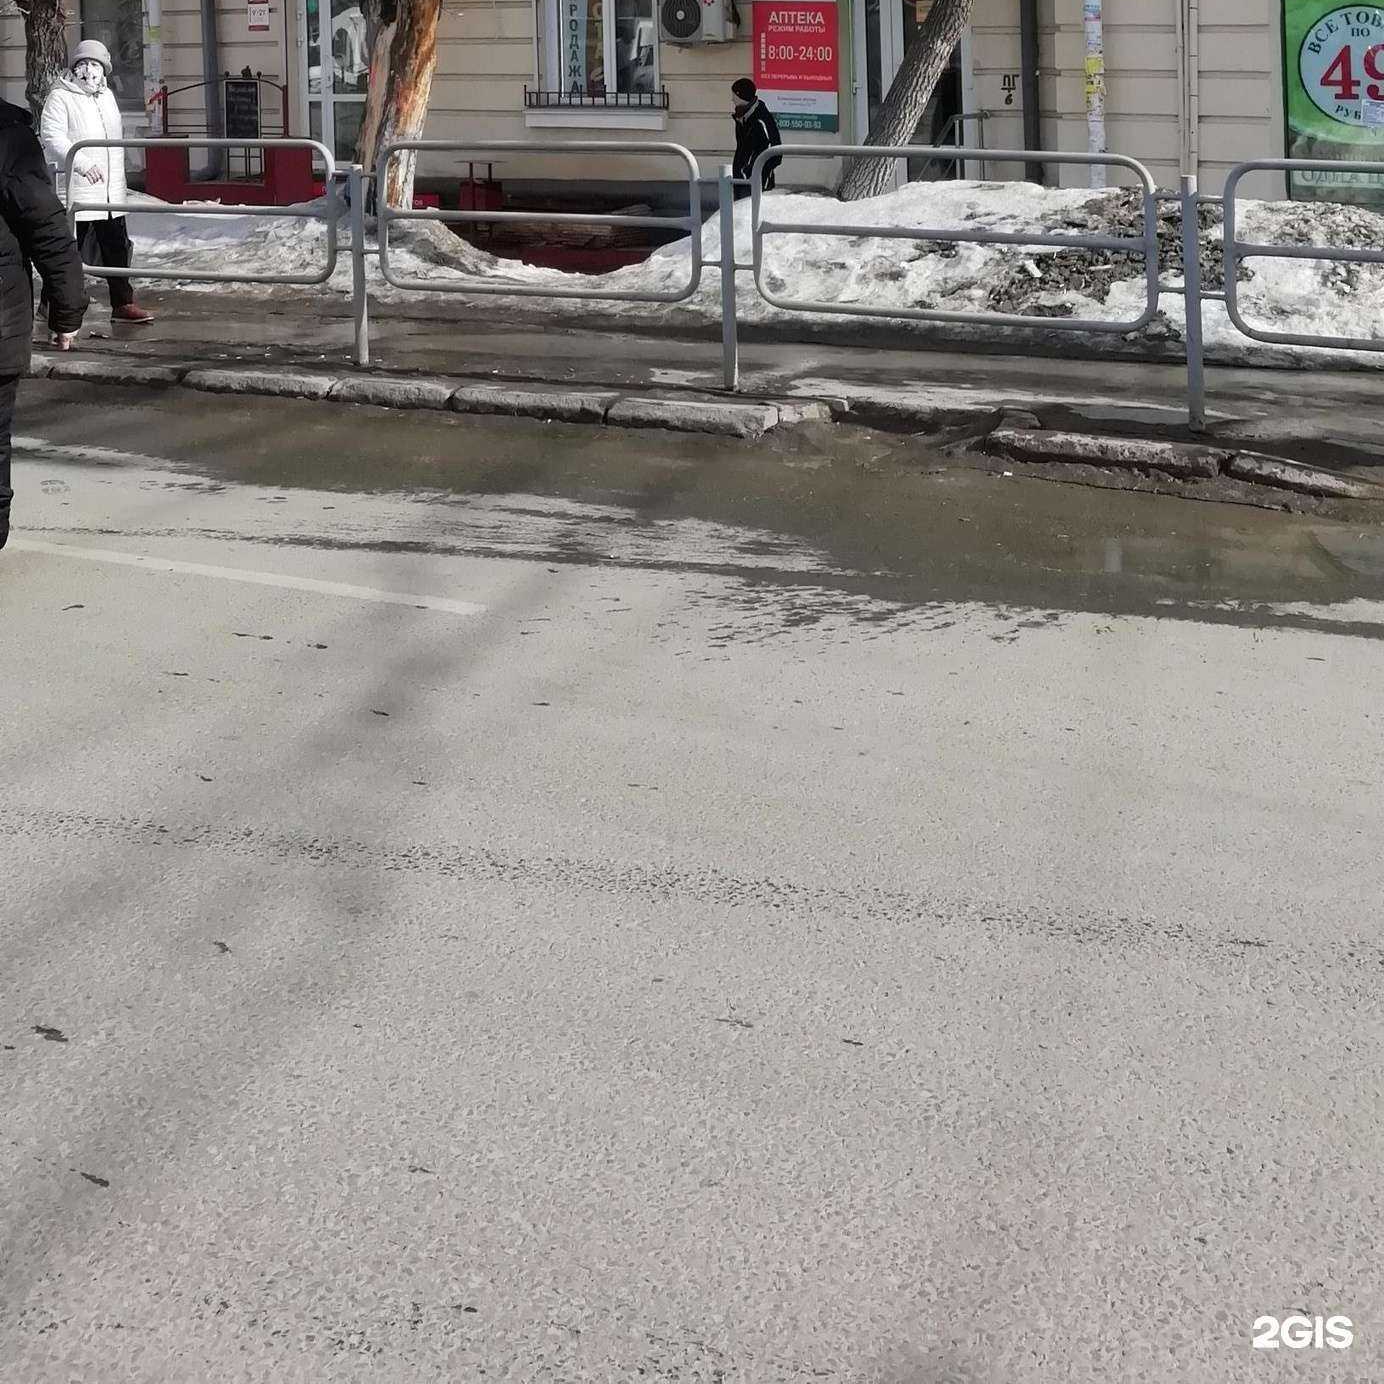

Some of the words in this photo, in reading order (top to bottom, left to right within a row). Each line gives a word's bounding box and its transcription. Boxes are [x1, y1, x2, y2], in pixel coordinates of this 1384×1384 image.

[768, 11, 825, 25] АПТЕКА
[795, 25, 826, 34] РАБОТЫ
[1307, 19, 1339, 55] ВСЕ
[1340, 10, 1384, 29] ТОВ
[1351, 27, 1370, 38] ПО
[768, 45, 833, 61] 8:00-24:00
[1320, 44, 1384, 101] 49
